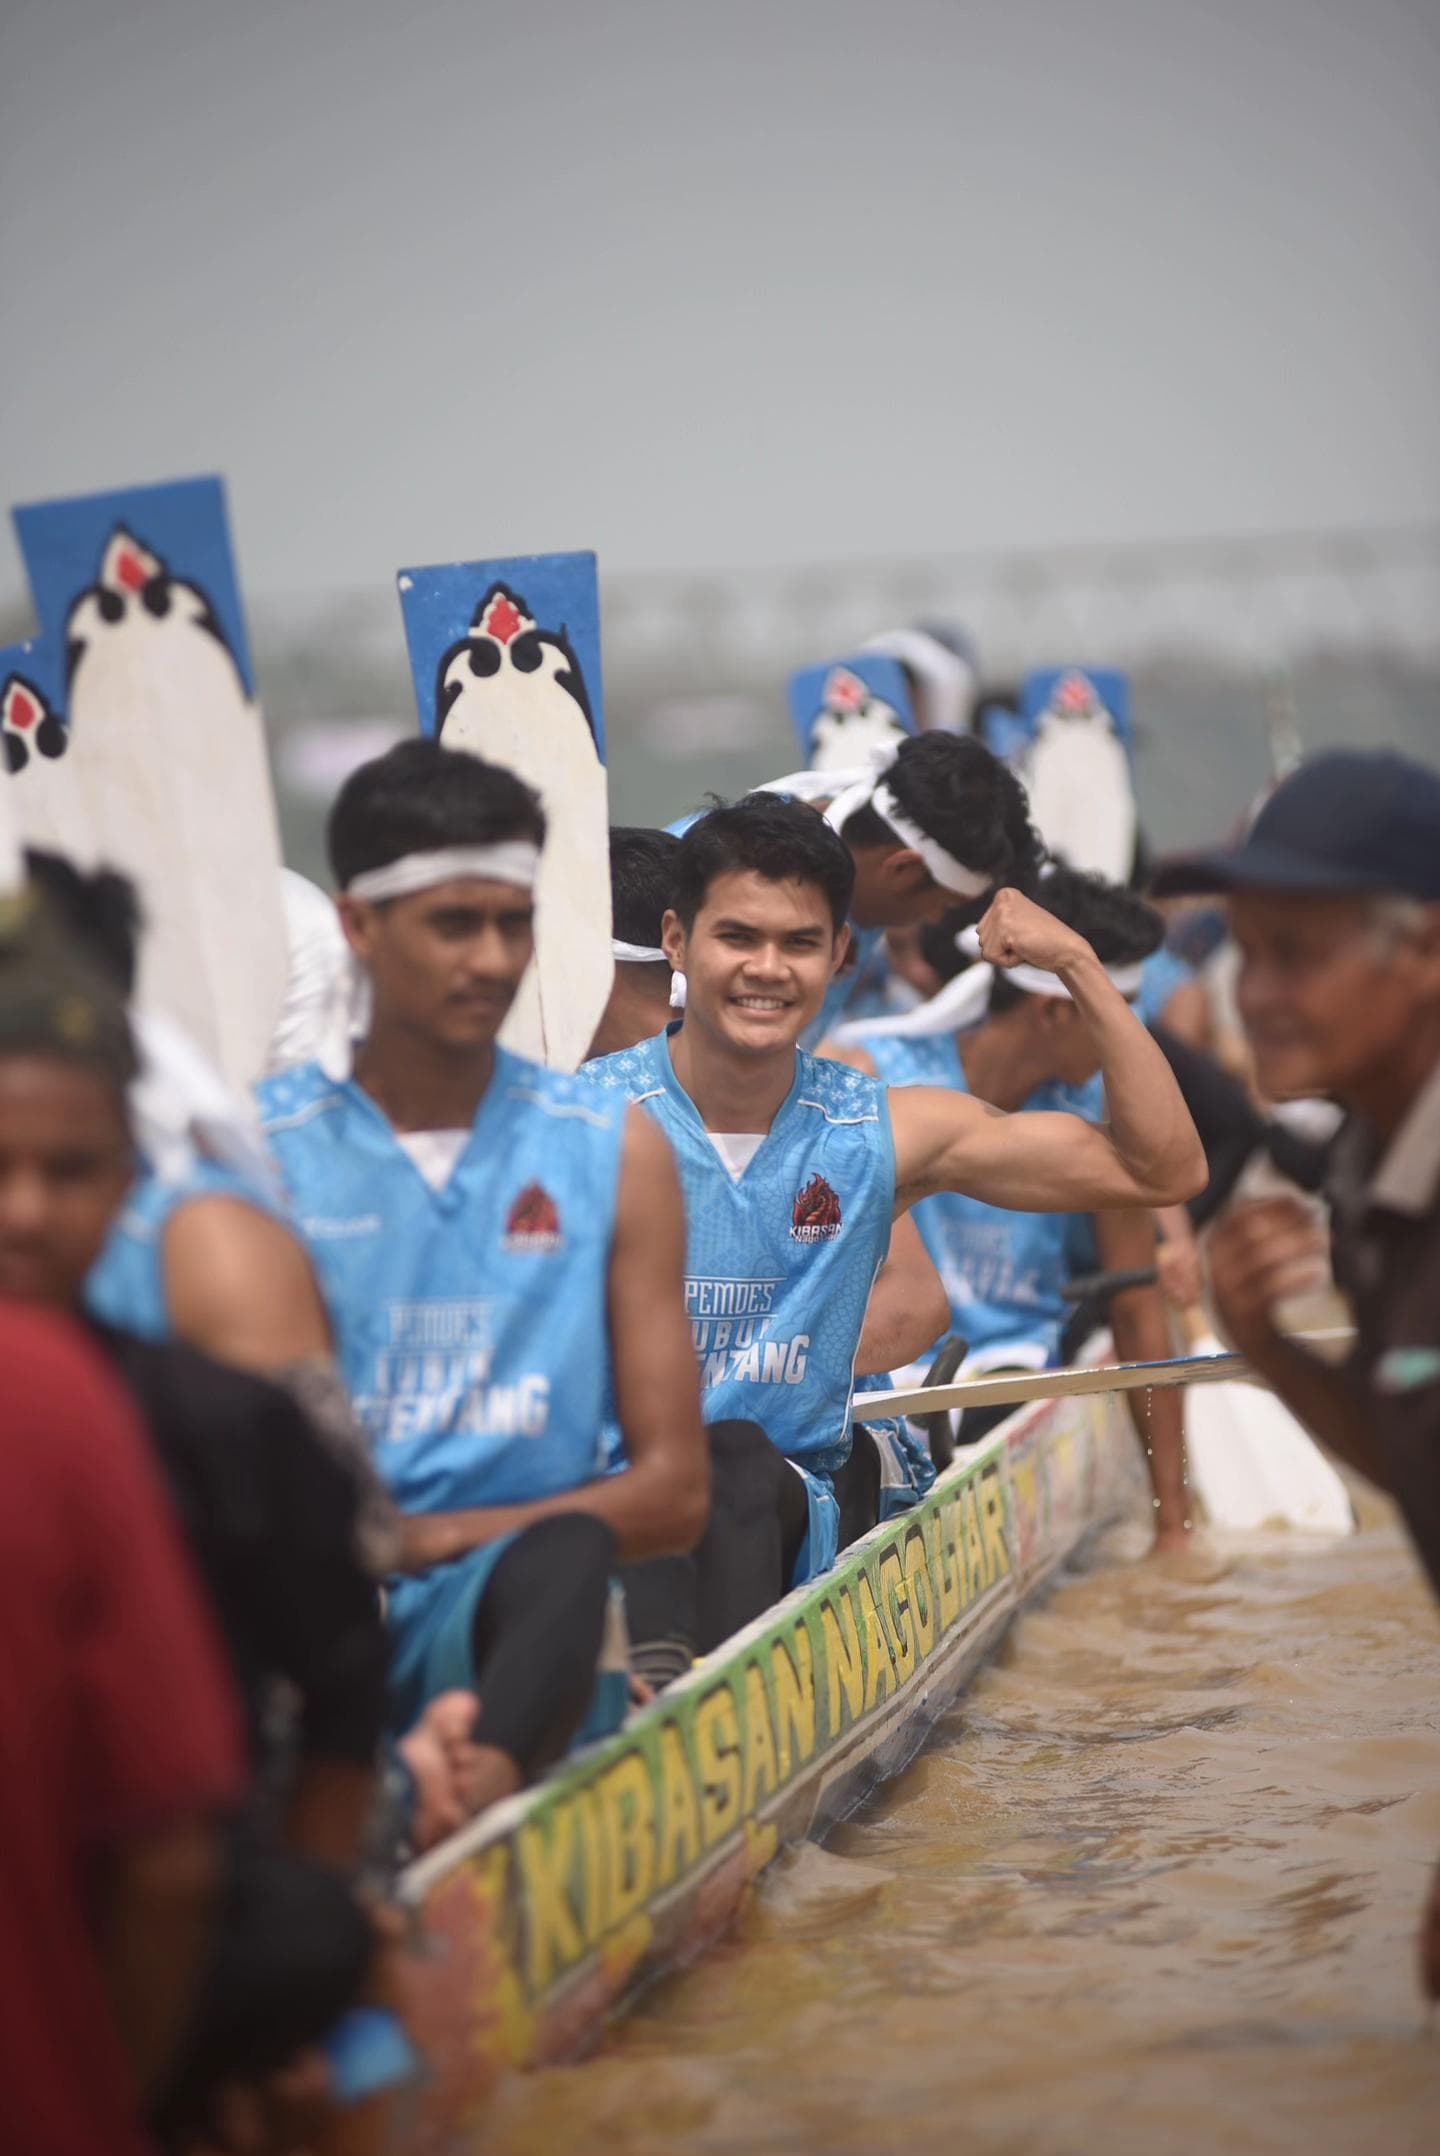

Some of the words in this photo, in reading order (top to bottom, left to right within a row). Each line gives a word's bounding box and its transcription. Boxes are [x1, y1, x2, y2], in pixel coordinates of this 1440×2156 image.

[684, 1279, 776, 1315] PEMDES
[515, 1616, 818, 1992] KIBASAN
[819, 1524, 936, 1738] NAGO
